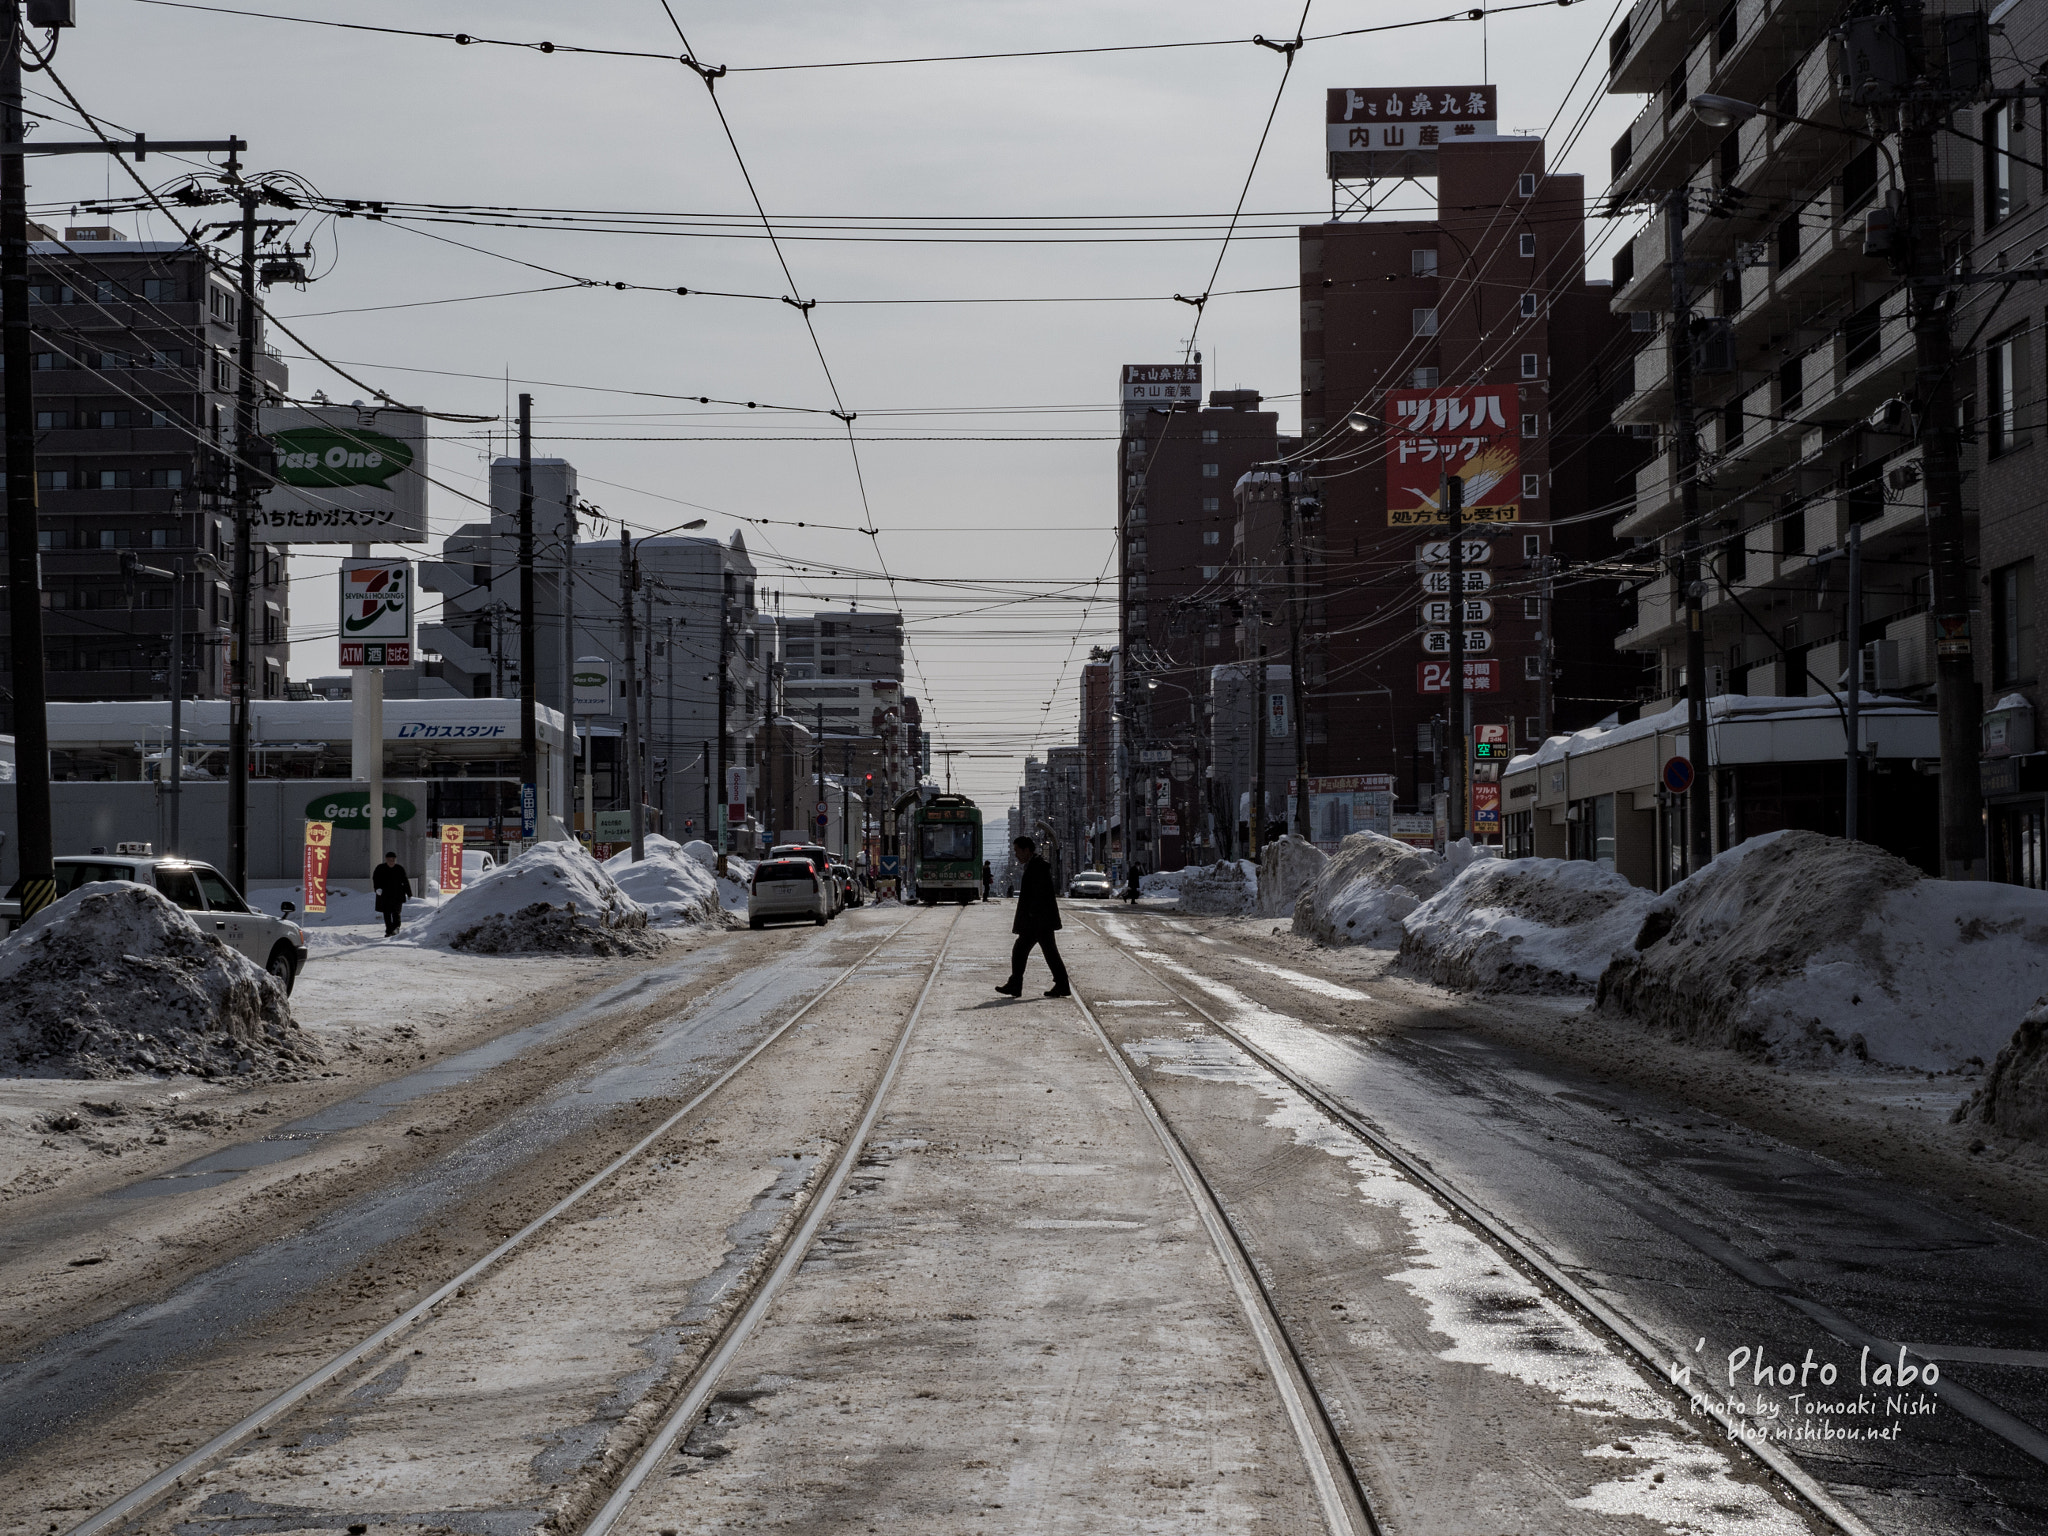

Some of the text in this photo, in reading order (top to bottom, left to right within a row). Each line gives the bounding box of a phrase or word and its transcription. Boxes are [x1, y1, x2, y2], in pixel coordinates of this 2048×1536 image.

[1133, 385, 1192, 397] 内山産業
[1397, 395, 1506, 432] ツルハ
[325, 446, 383, 468] One
[1399, 437, 1489, 464] ドラッグ
[1431, 544, 1483, 560] くり
[1429, 572, 1484, 592] 化品
[1431, 602, 1483, 621] 日品
[342, 647, 363, 662] ATM
[368, 647, 383, 662] 酒
[388, 647, 409, 662] たばこ
[398, 722, 506, 738] LPガススタンド
[1480, 725, 1504, 743] P
[1477, 742, 1491, 757] 空
[1475, 786, 1497, 794] ツルハ
[324, 803, 360, 818] Gas
[523, 787, 535, 830] 吉田眼科
[1477, 811, 1487, 821] P
